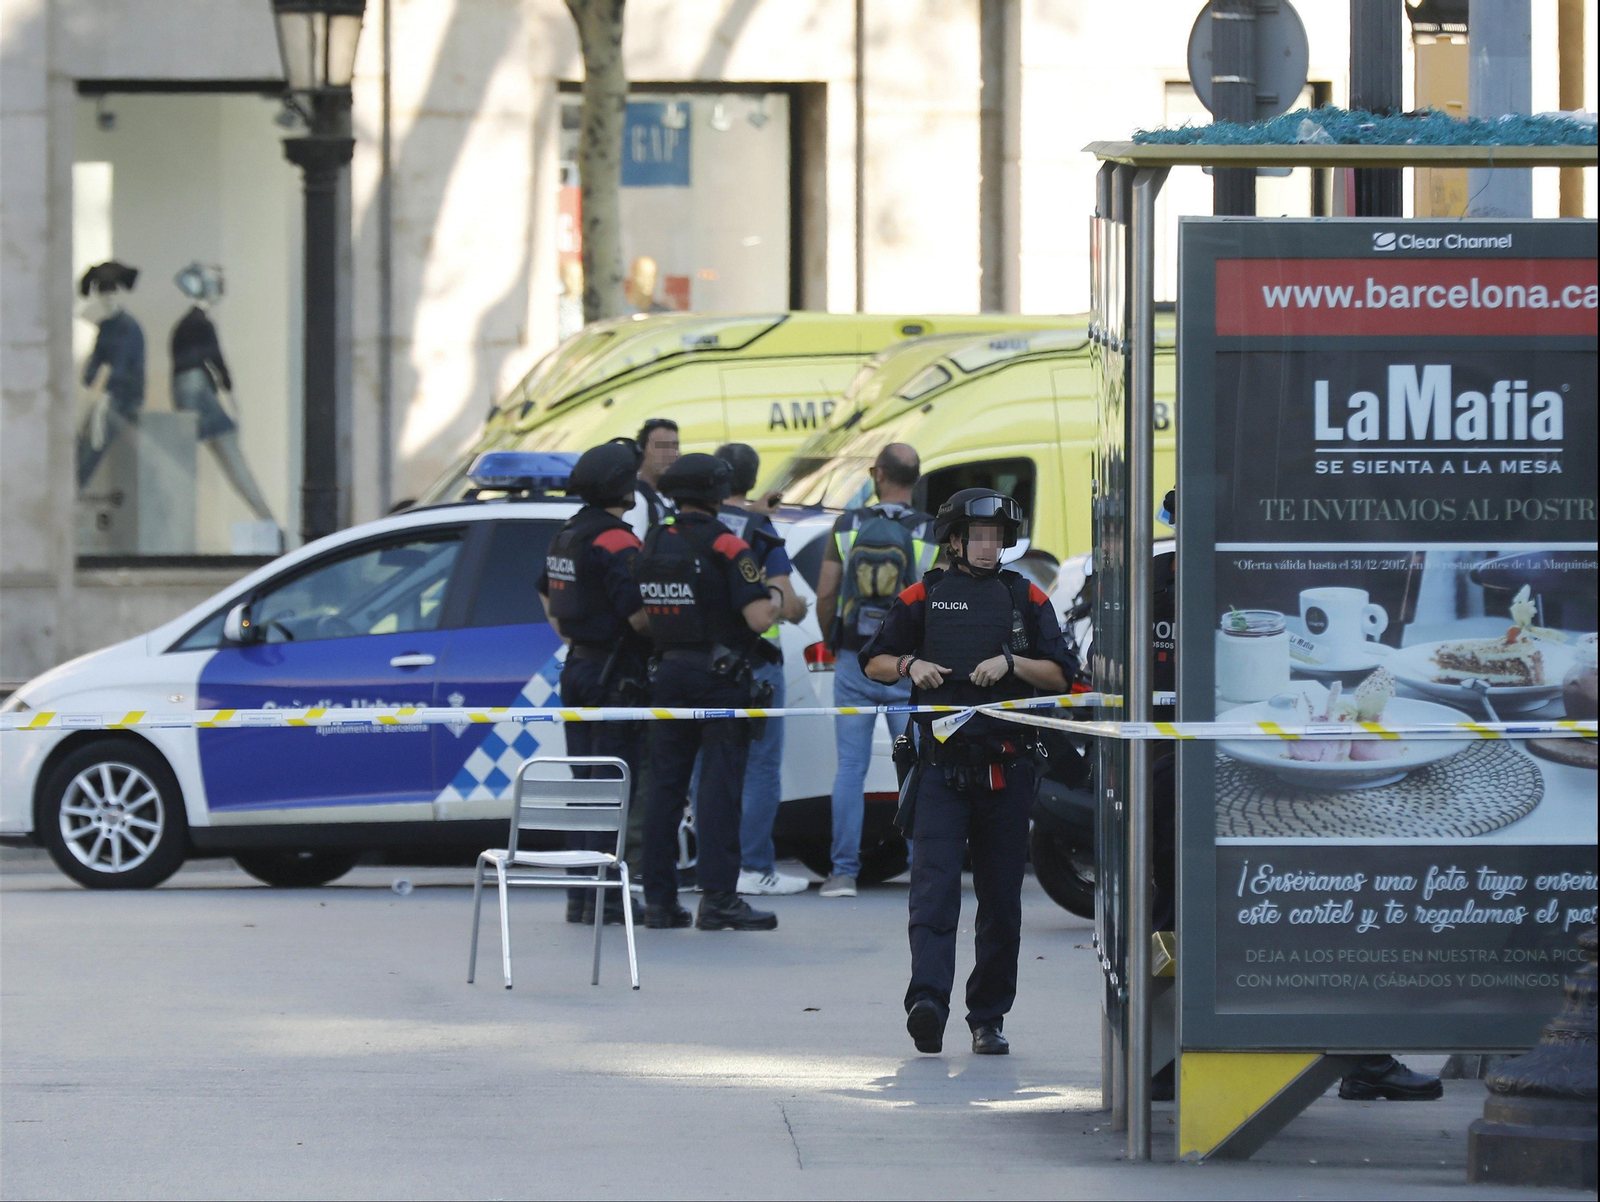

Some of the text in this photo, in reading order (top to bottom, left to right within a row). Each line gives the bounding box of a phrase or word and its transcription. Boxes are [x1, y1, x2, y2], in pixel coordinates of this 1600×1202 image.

[1398, 233, 1512, 249] Clear Channel
[1262, 277, 1598, 309] www.barcelona.ca
[1315, 460, 1562, 474] SE SIENTA A LA MESA
[1259, 499, 1597, 521] TE INVITAMOS AL POSTR
[1275, 559, 1306, 571] válida
[1309, 559, 1337, 571] hasta
[1339, 559, 1349, 571] el
[1511, 559, 1525, 570] de
[1528, 559, 1541, 570] La
[639, 582, 693, 598] POLICIA
[932, 601, 969, 610] POLICIA
[1374, 875, 1417, 891] una
[1423, 865, 1469, 901] foto
[1477, 865, 1528, 900] tuya
[1238, 900, 1281, 925] este
[1289, 900, 1354, 924] cartel
[1355, 908, 1380, 933] y
[1384, 900, 1408, 924] te
[1415, 900, 1529, 933] regalamos
[1535, 900, 1559, 924] el
[1245, 949, 1285, 962] DEJA
[1289, 949, 1301, 962] A
[1305, 949, 1334, 962] LOS
[1338, 949, 1399, 963] PEQUES
[1403, 949, 1423, 962] EN
[1427, 949, 1498, 962] NUESTRA
[1503, 949, 1549, 962] ZONA
[1236, 974, 1272, 988] CON
[1276, 974, 1369, 990] MONITOR/A
[1373, 971, 1452, 990] (SÁBADOS
[1456, 974, 1466, 988] Y
[1470, 973, 1560, 988] DOMINGOS
